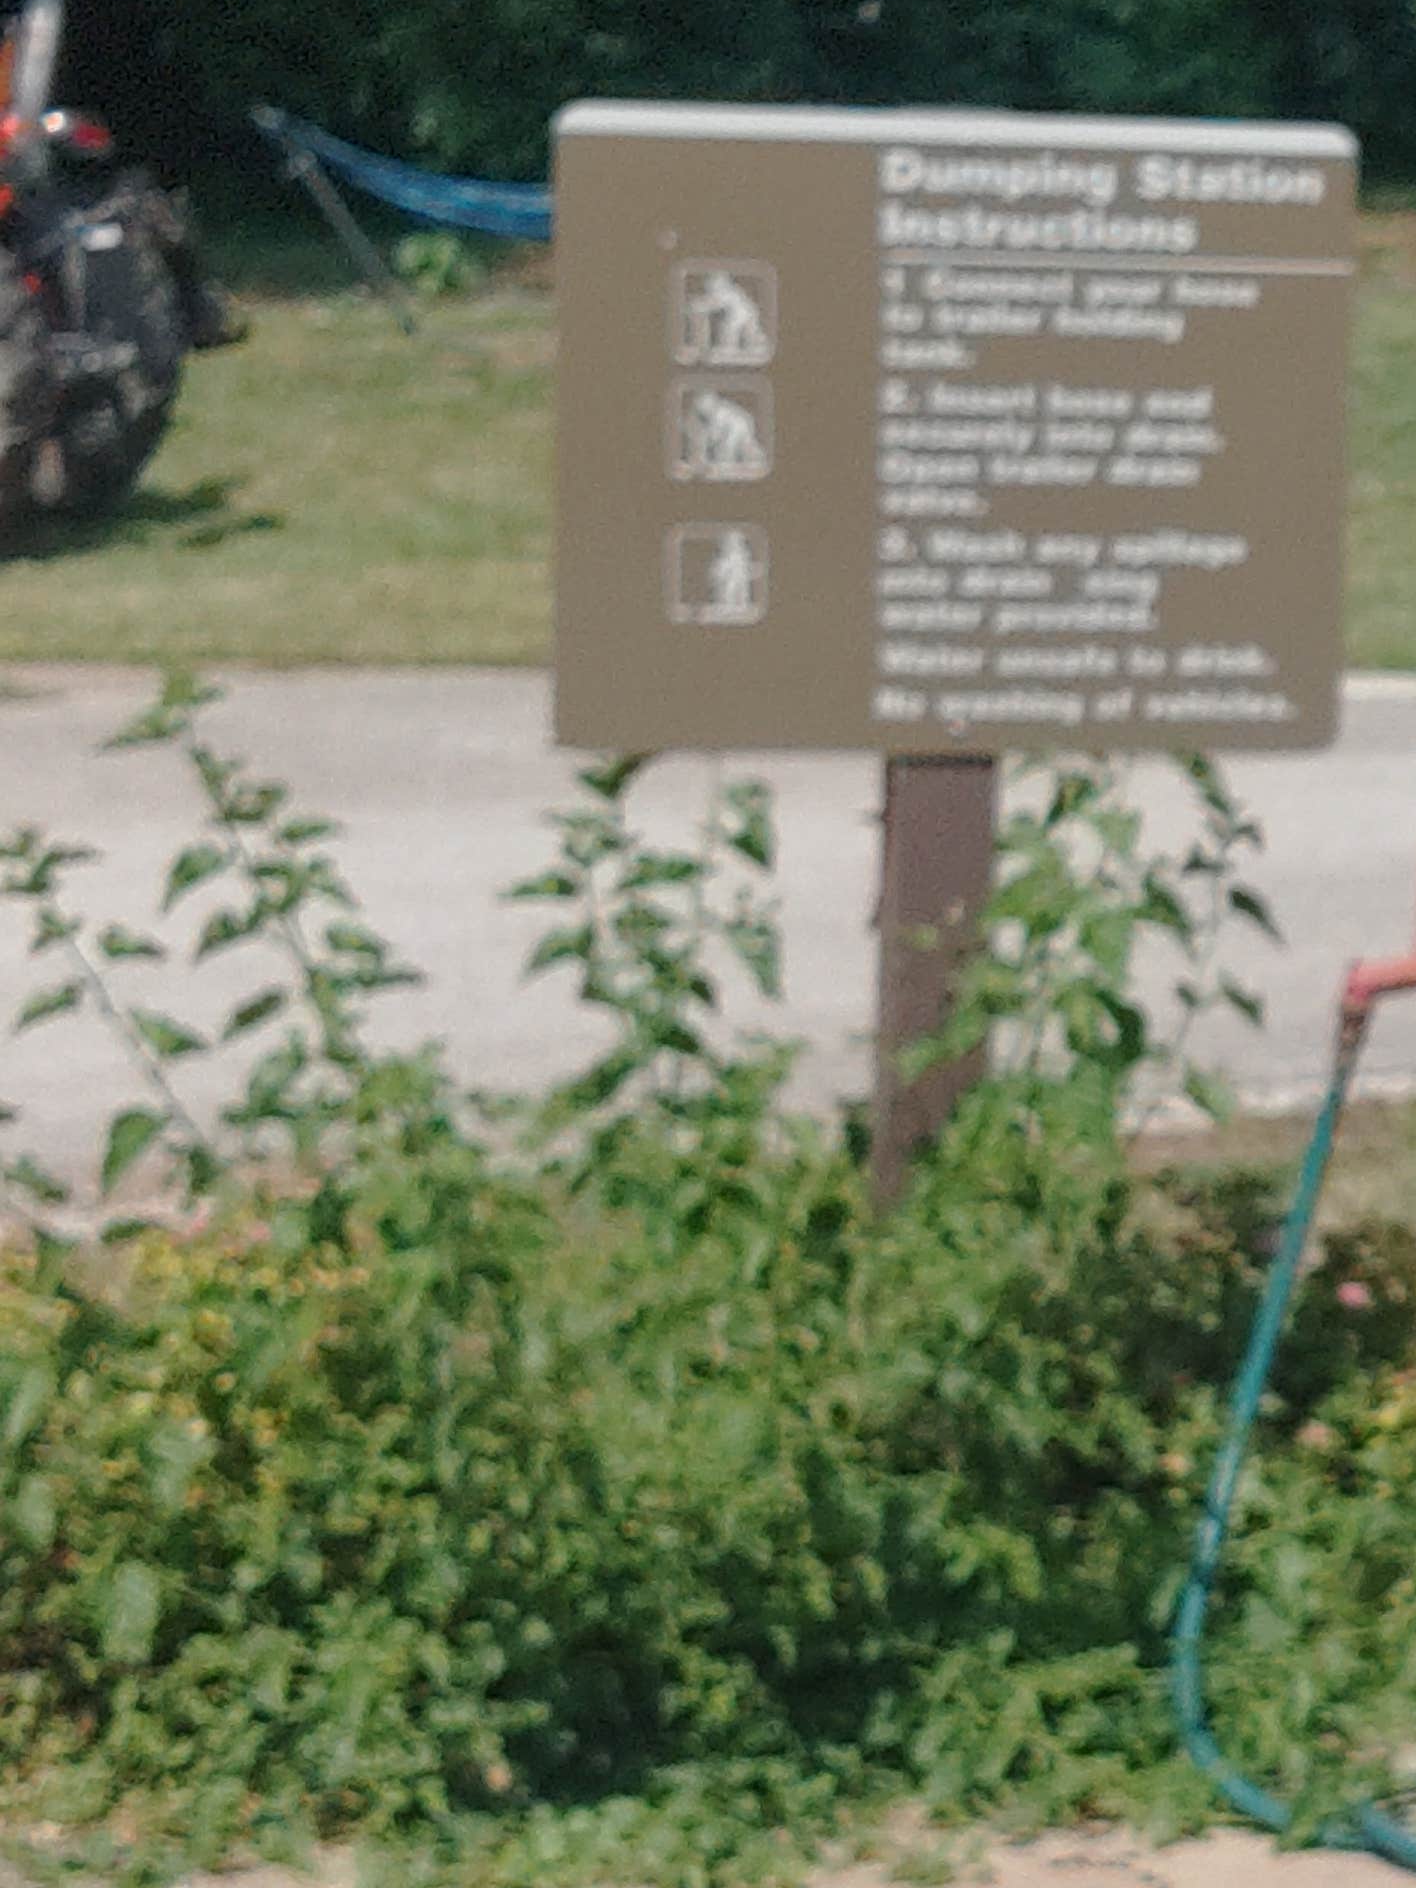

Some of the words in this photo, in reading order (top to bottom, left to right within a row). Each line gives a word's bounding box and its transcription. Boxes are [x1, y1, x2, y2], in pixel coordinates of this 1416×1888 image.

[878, 147, 1119, 207] Dumping
[1134, 154, 1326, 205] Station
[877, 202, 1198, 253] Instructions
